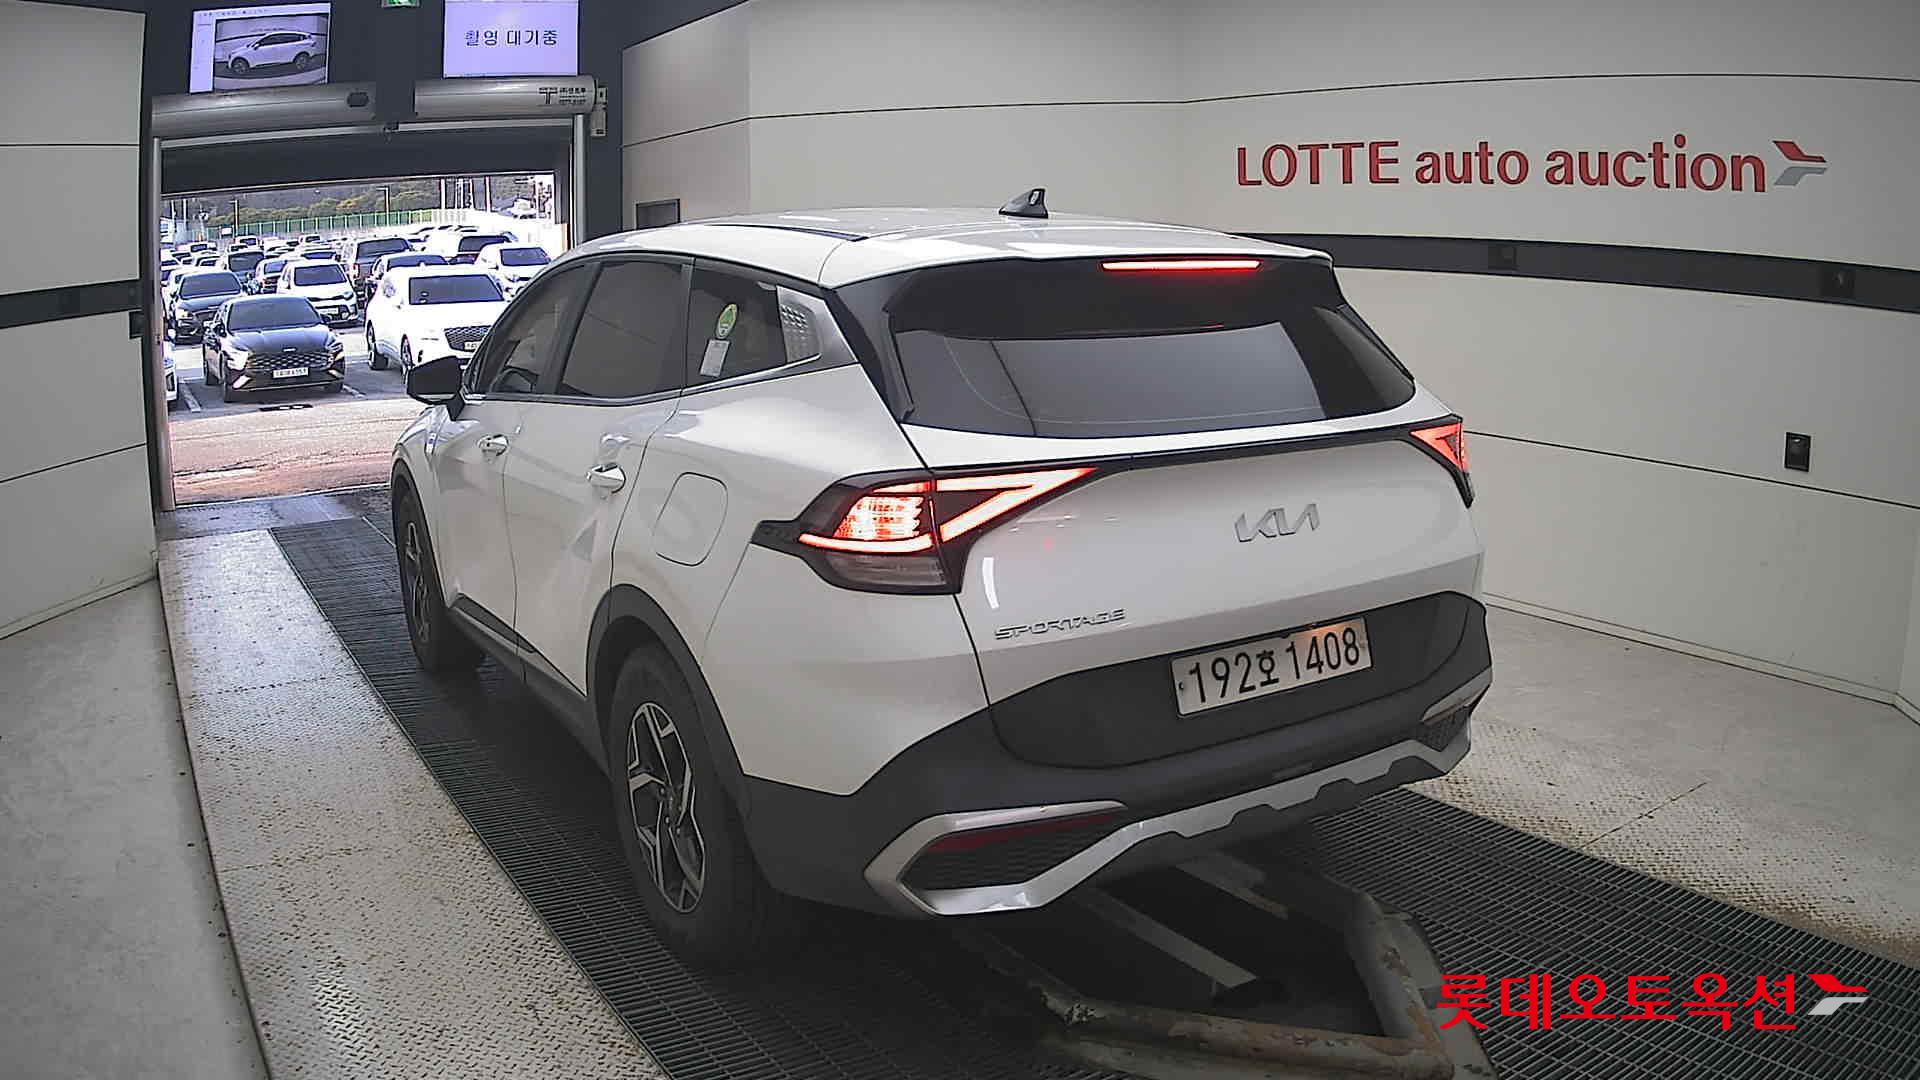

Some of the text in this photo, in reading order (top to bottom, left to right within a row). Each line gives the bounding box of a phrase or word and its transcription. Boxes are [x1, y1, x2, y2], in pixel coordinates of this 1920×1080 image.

[506, 30, 559, 47] 대기중
[1237, 134, 1766, 193] LOTTE auto auction
[994, 609, 1126, 640] SPORTAGE
[1188, 626, 1361, 705] 192호 1408
